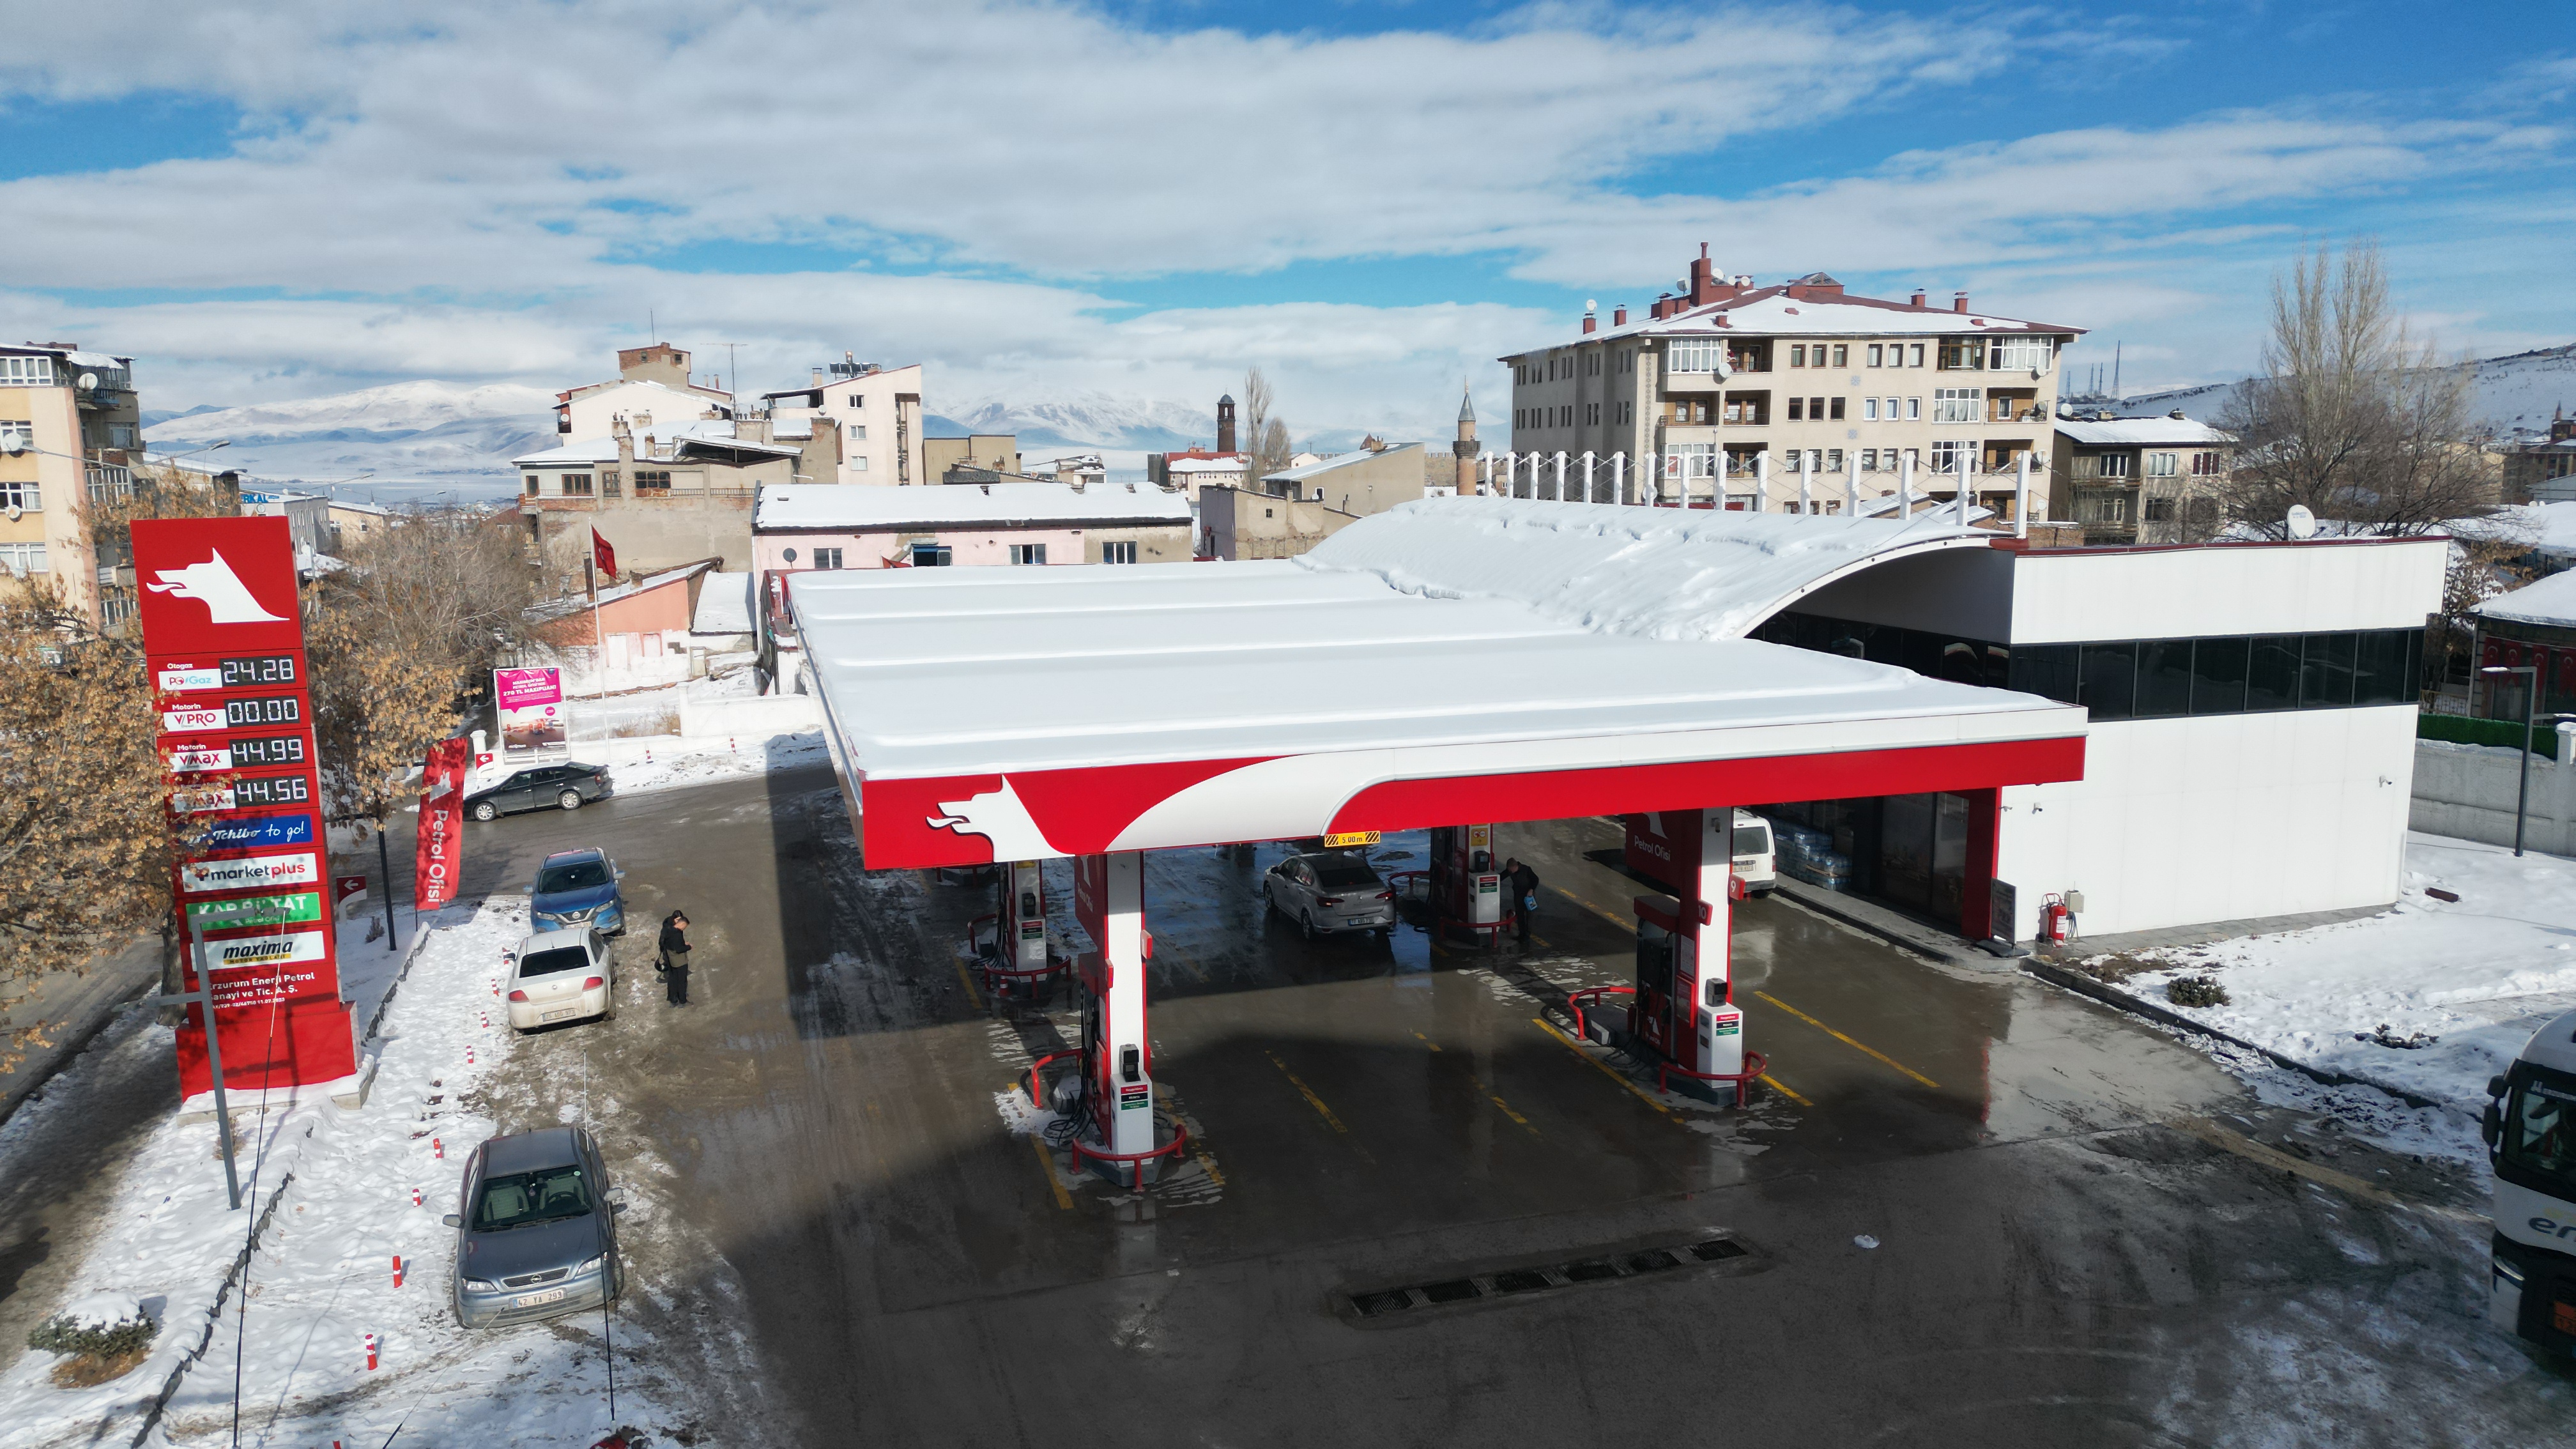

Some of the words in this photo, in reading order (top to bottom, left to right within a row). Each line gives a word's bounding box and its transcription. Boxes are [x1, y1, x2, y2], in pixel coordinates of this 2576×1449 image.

[224, 659, 295, 683] 24.28
[227, 699, 298, 723] 00.00
[233, 739, 303, 762] 44.99
[237, 778, 307, 802] 44.56
[266, 824, 281, 837] to
[287, 820, 305, 842] go!
[431, 809, 448, 859] Petrol
[1634, 835, 1653, 854] Petrol
[1655, 844, 1671, 862] Ofisi
[210, 862, 305, 882] marketplus
[427, 863, 445, 902] Ofisi
[1731, 880, 1736, 893] 9
[270, 896, 307, 911] TAT
[1698, 905, 1706, 919] 10
[223, 940, 293, 959] maxima
[284, 972, 315, 983] Petrol
[211, 991, 240, 1000] anayi
[518, 1298, 528, 1307] 42
[533, 1296, 542, 1304] YA
[548, 1291, 562, 1301] 293
